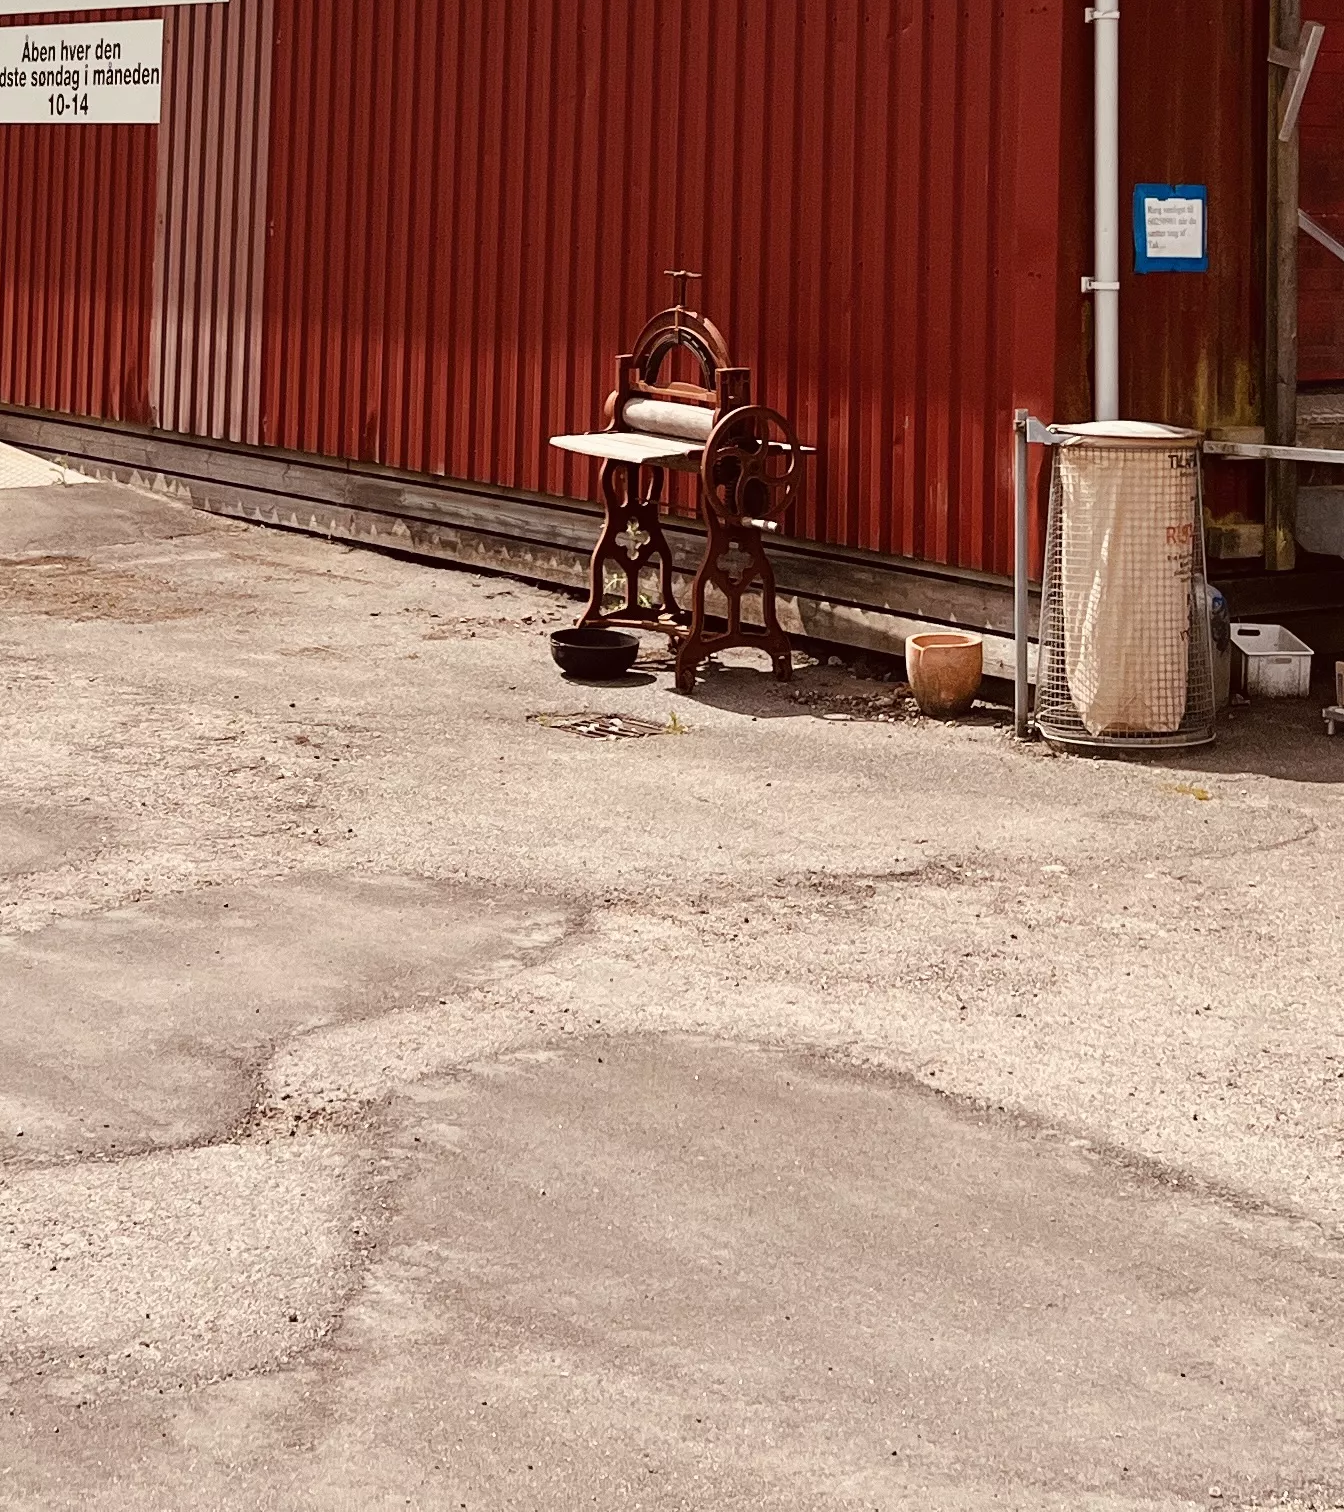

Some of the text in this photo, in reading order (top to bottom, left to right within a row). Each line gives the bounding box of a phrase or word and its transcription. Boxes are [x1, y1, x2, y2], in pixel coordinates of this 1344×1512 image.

[22, 35, 122, 63] Åben hver den
[31, 66, 80, 91] søndag
[83, 65, 89, 86] i
[93, 62, 160, 86] måneden
[48, 93, 89, 116] 10-14
